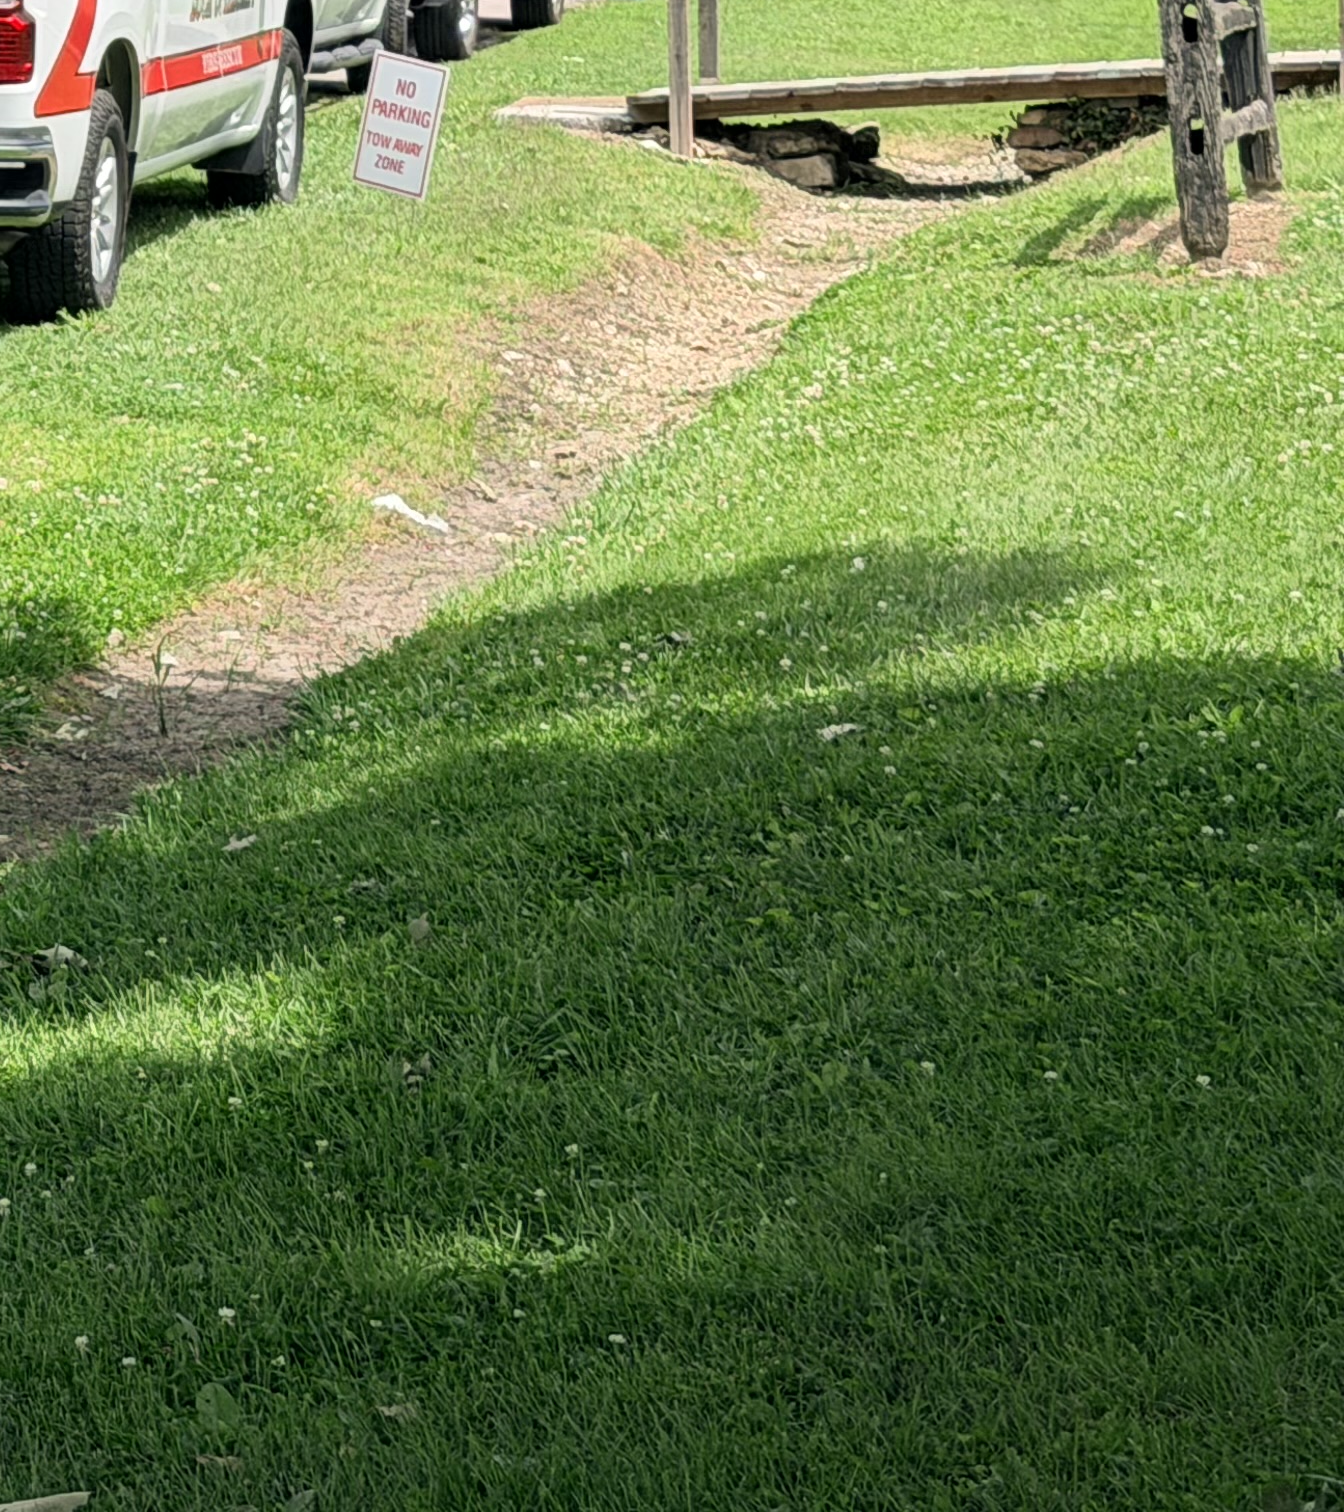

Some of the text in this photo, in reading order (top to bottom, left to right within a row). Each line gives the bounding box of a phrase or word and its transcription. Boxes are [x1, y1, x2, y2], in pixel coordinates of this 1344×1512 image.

[395, 78, 417, 99] NO
[371, 98, 432, 130] PARKING
[366, 129, 424, 158] TOW AWAY
[374, 154, 406, 175] ZONE
